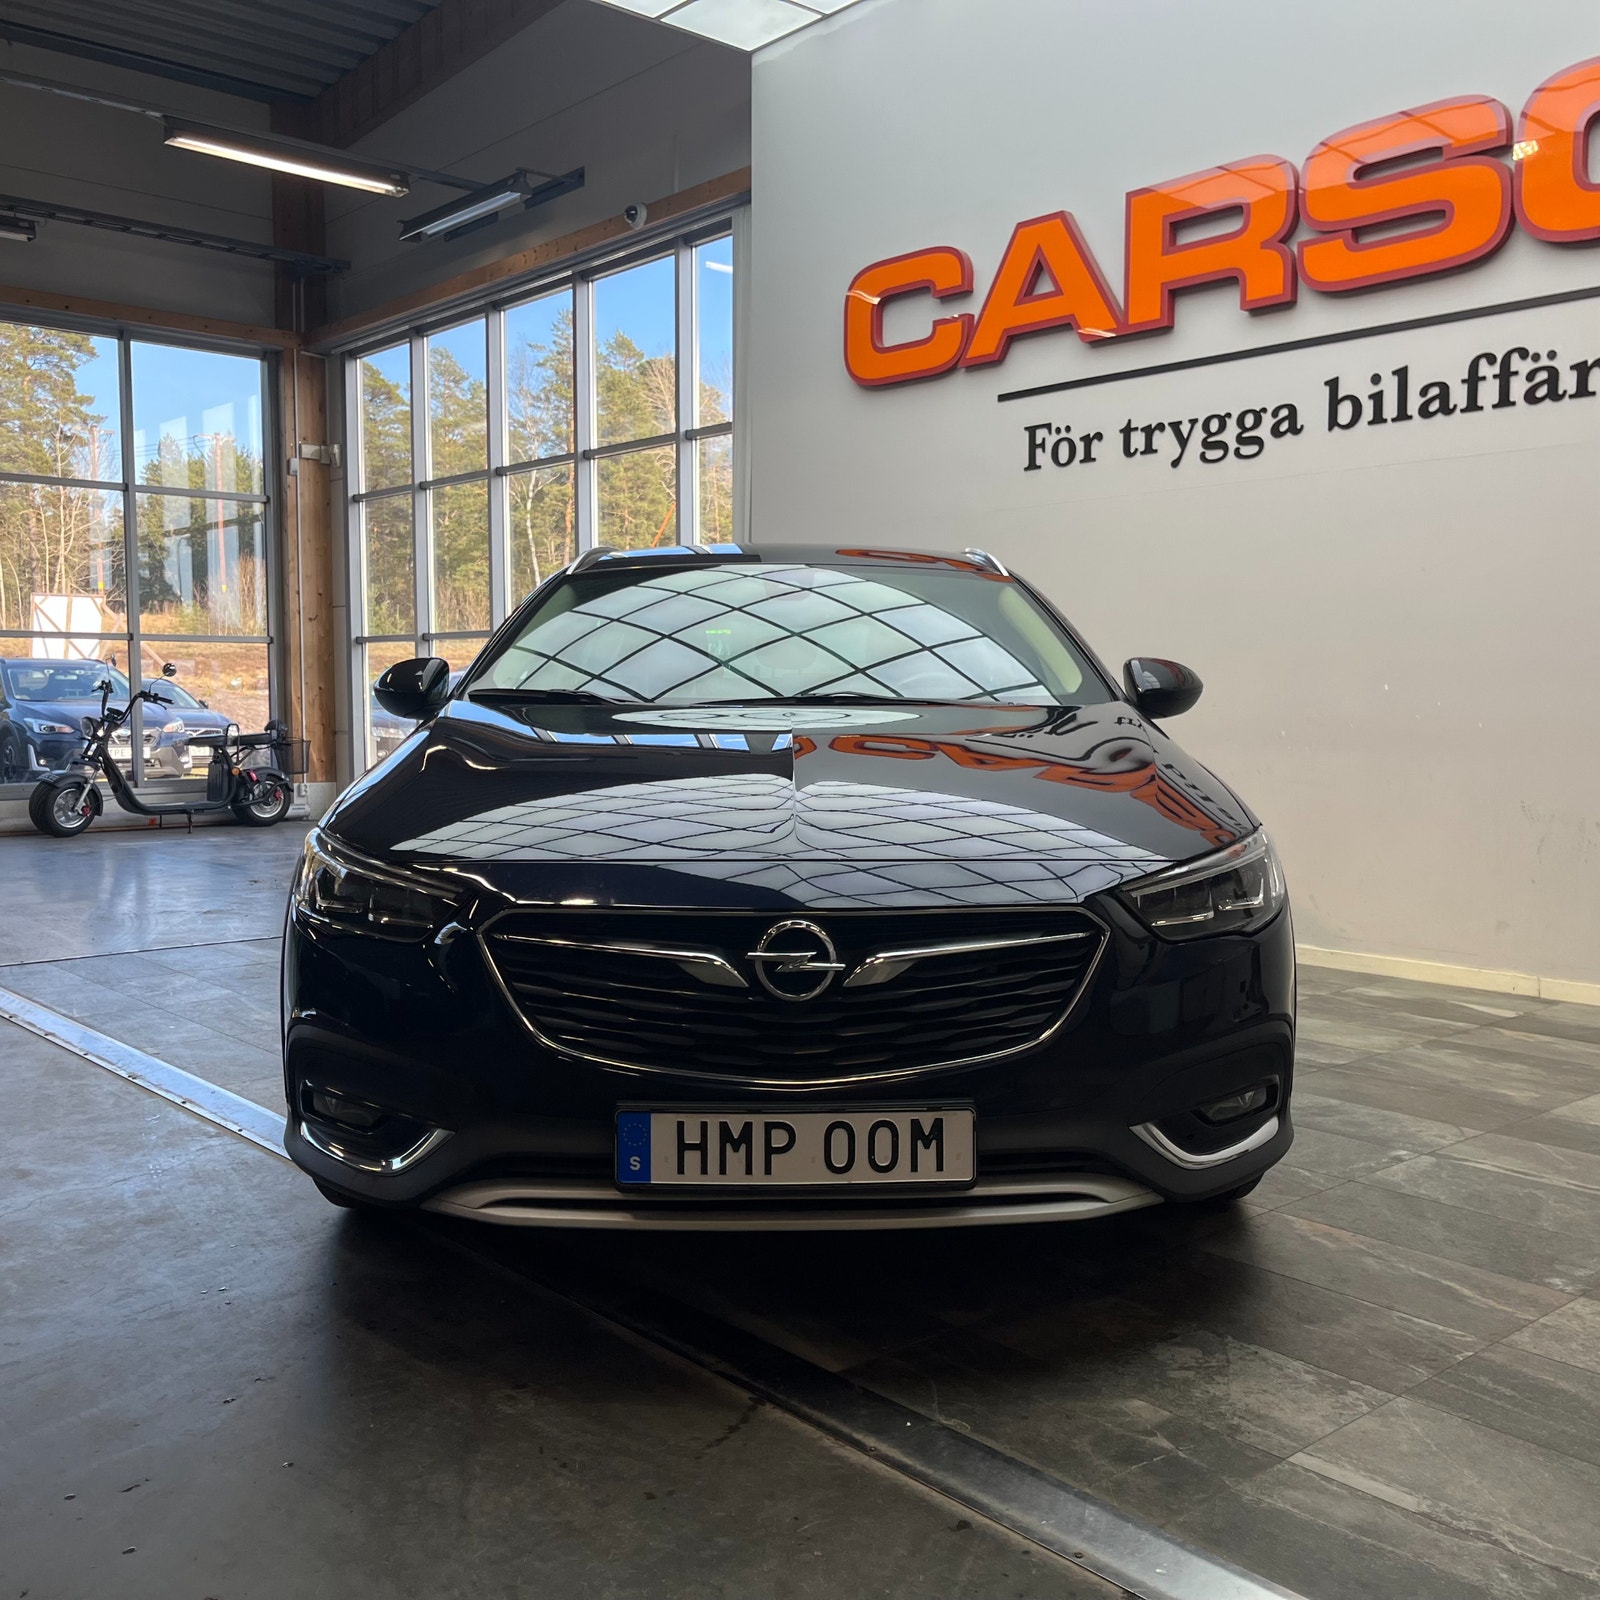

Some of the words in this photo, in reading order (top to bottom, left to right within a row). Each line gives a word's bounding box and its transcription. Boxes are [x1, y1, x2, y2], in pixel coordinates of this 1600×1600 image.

[1023, 422, 1104, 472] För
[1119, 402, 1305, 469] trygga
[629, 1155, 641, 1171] S
[675, 1119, 797, 1176] HMP
